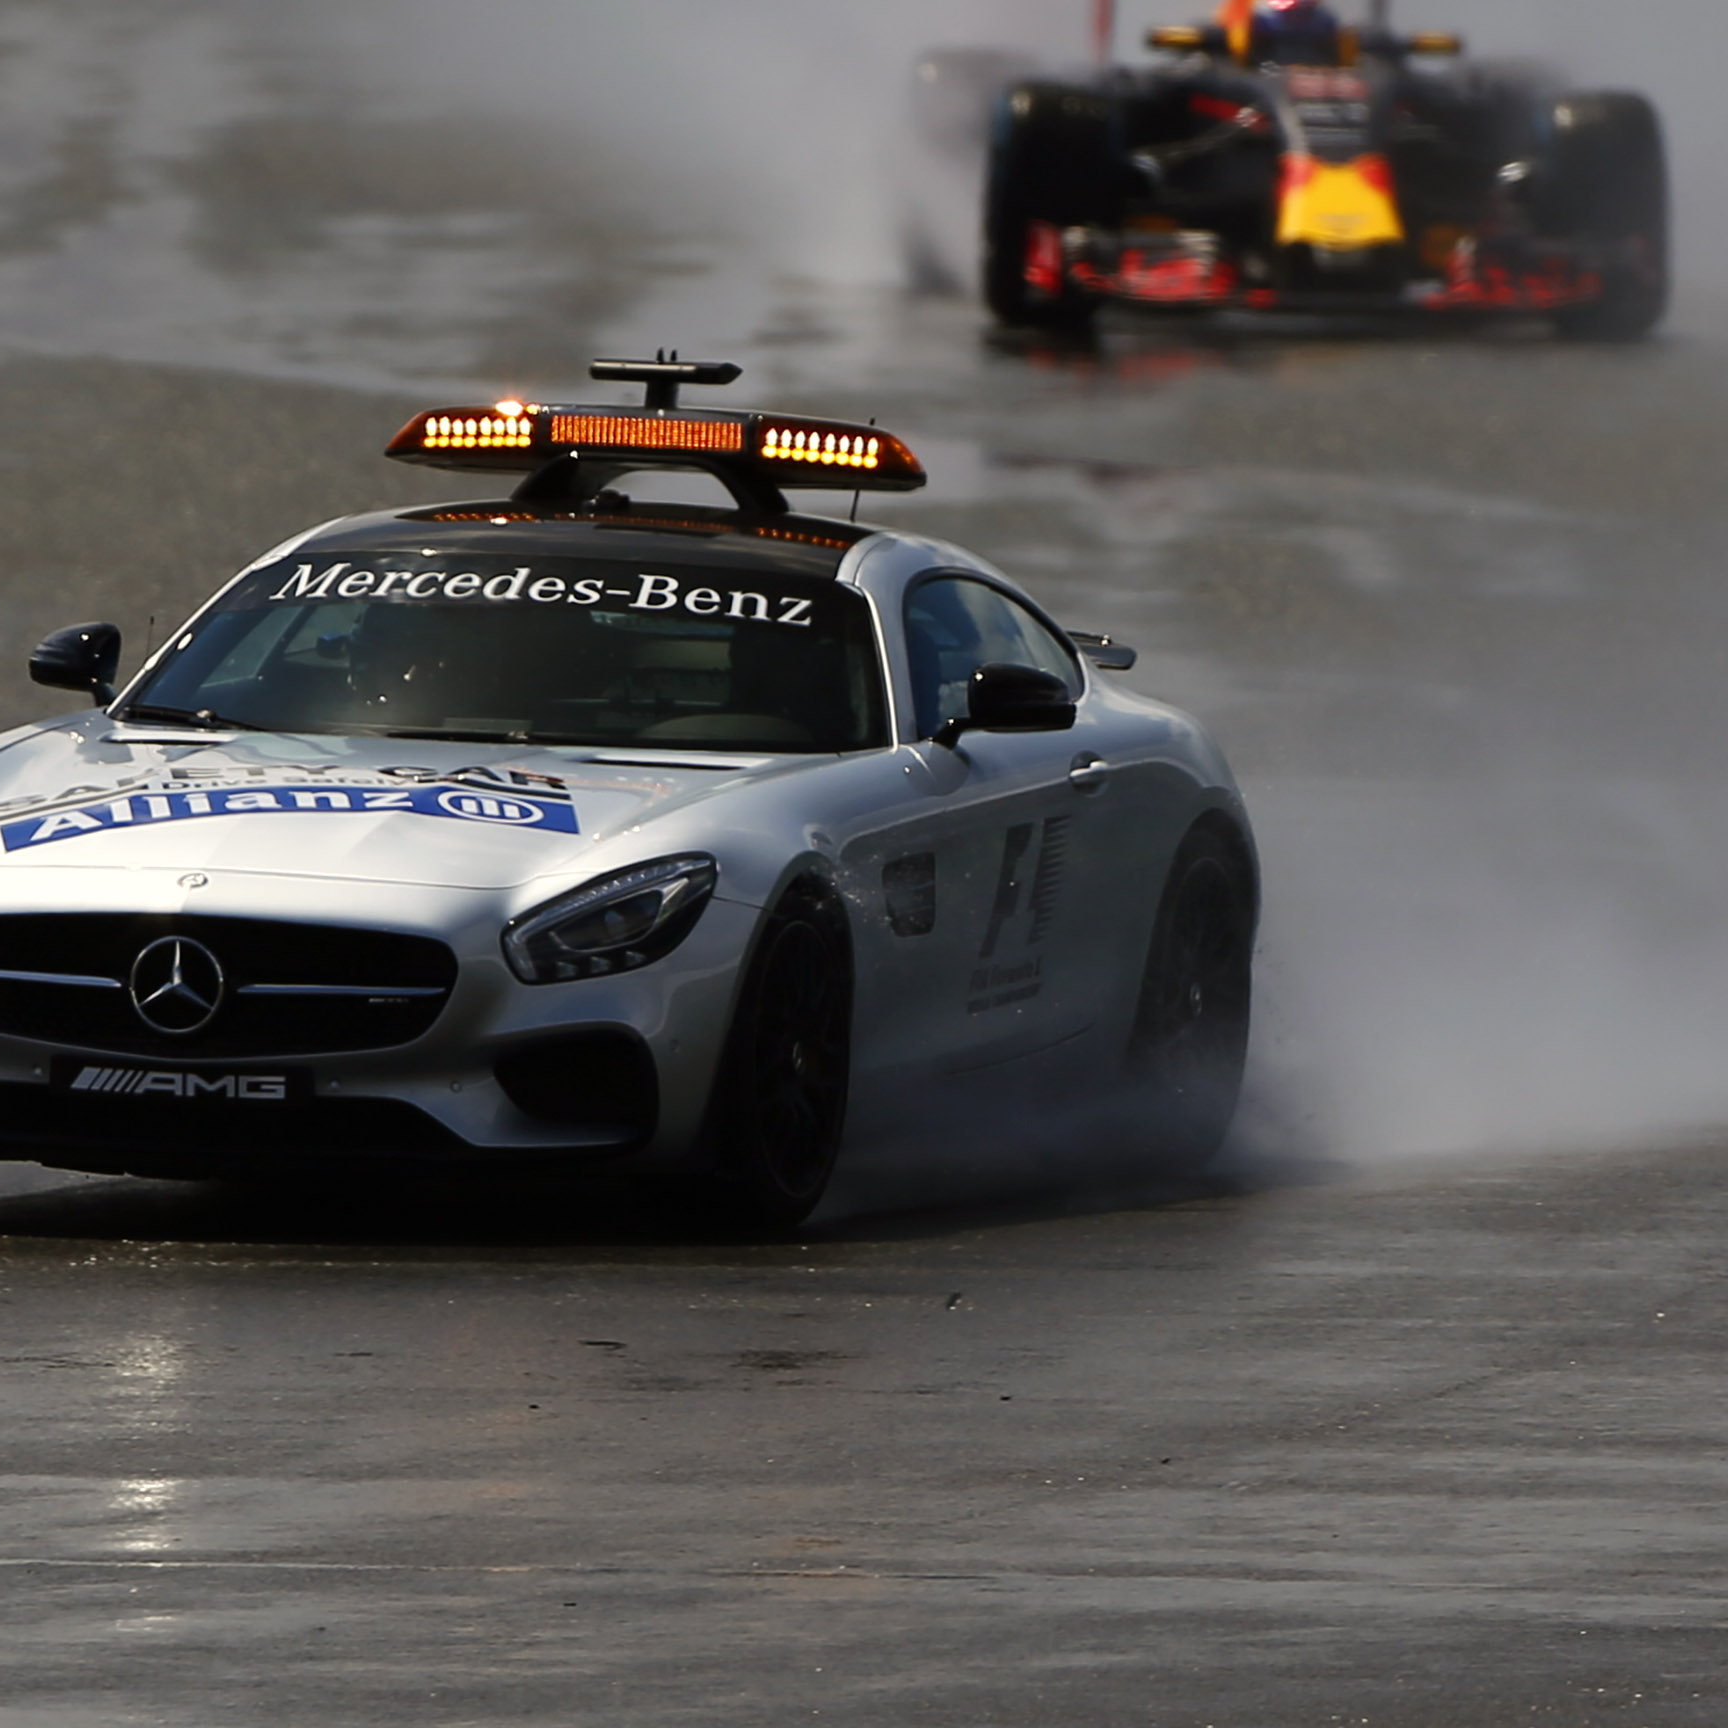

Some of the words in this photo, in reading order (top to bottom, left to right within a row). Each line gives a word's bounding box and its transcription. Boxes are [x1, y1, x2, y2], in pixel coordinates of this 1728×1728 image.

[270, 562, 814, 627] Mercedes-Benz
[29, 786, 413, 842] Allianz
[134, 1070, 286, 1099] AMG
